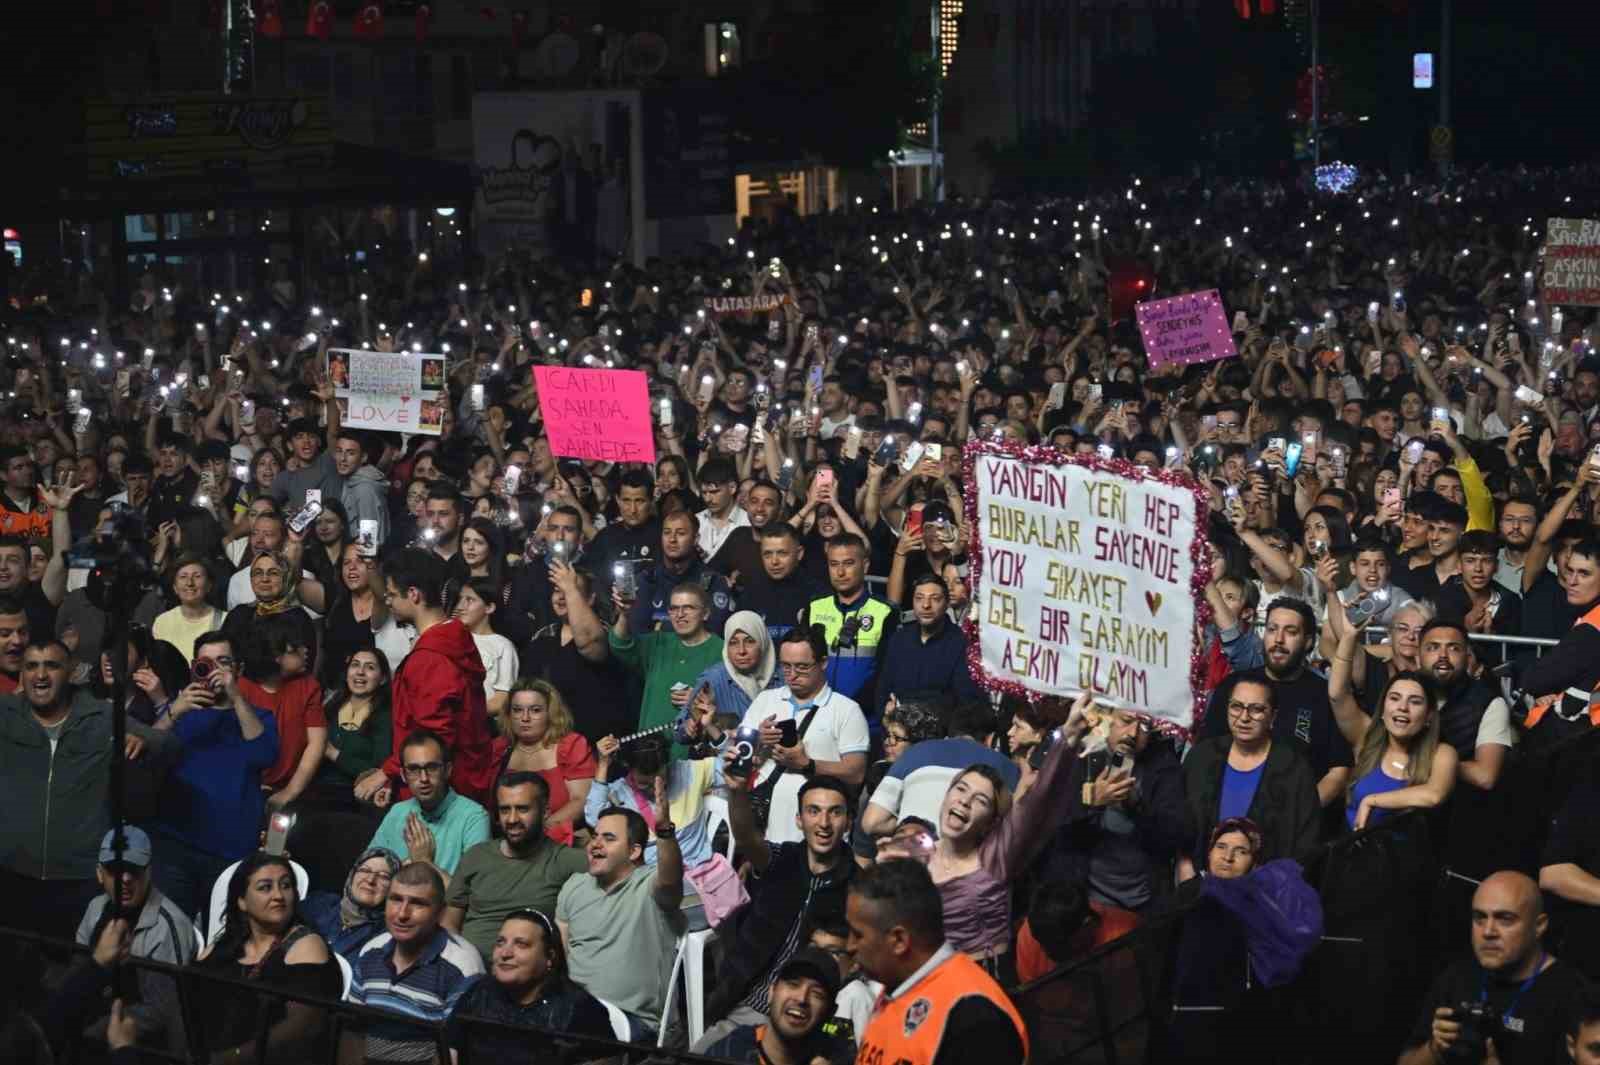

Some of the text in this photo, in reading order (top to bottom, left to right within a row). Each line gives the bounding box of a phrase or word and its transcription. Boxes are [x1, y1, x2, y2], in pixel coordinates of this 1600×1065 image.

[351, 406, 408, 423] LOVE
[986, 459, 1181, 539] YANGIN YERI HEP
[988, 503, 1180, 584] BURALAR SAYENDE
[988, 546, 1026, 589] YOK
[988, 588, 1168, 668] GEL BIR SARAYIM
[1001, 637, 1148, 706] ASKIN OLAYIM
